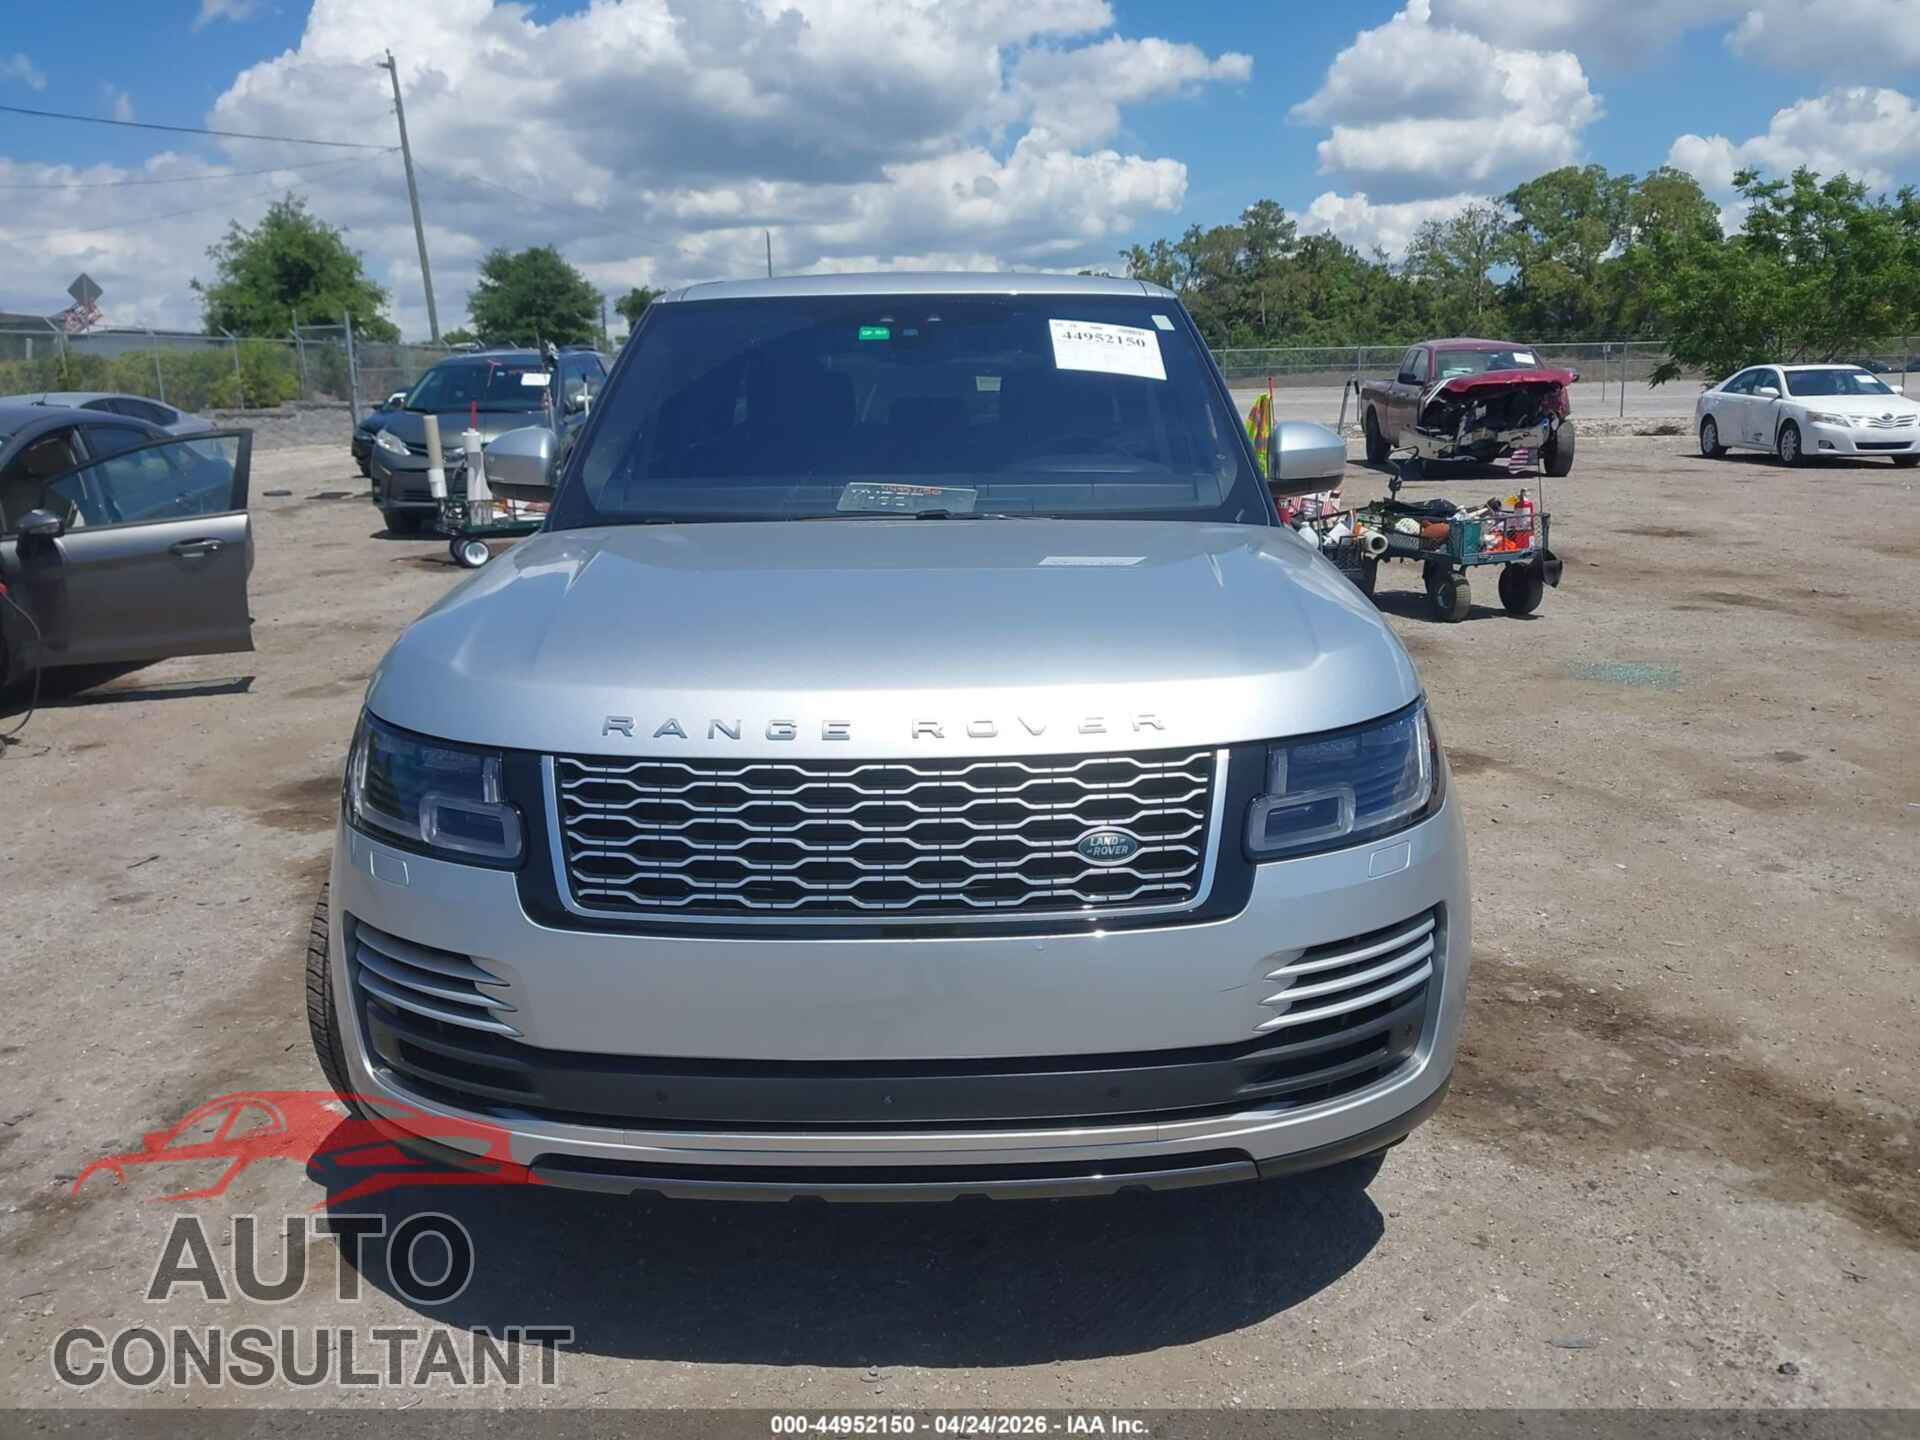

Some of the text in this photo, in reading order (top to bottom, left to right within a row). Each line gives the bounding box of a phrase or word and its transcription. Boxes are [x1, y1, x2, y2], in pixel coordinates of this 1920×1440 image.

[1062, 331, 1146, 348] 44952150
[602, 713, 1165, 740] RANGE ROVER
[1090, 836, 1119, 846] LAND
[1093, 845, 1129, 856] ROVER
